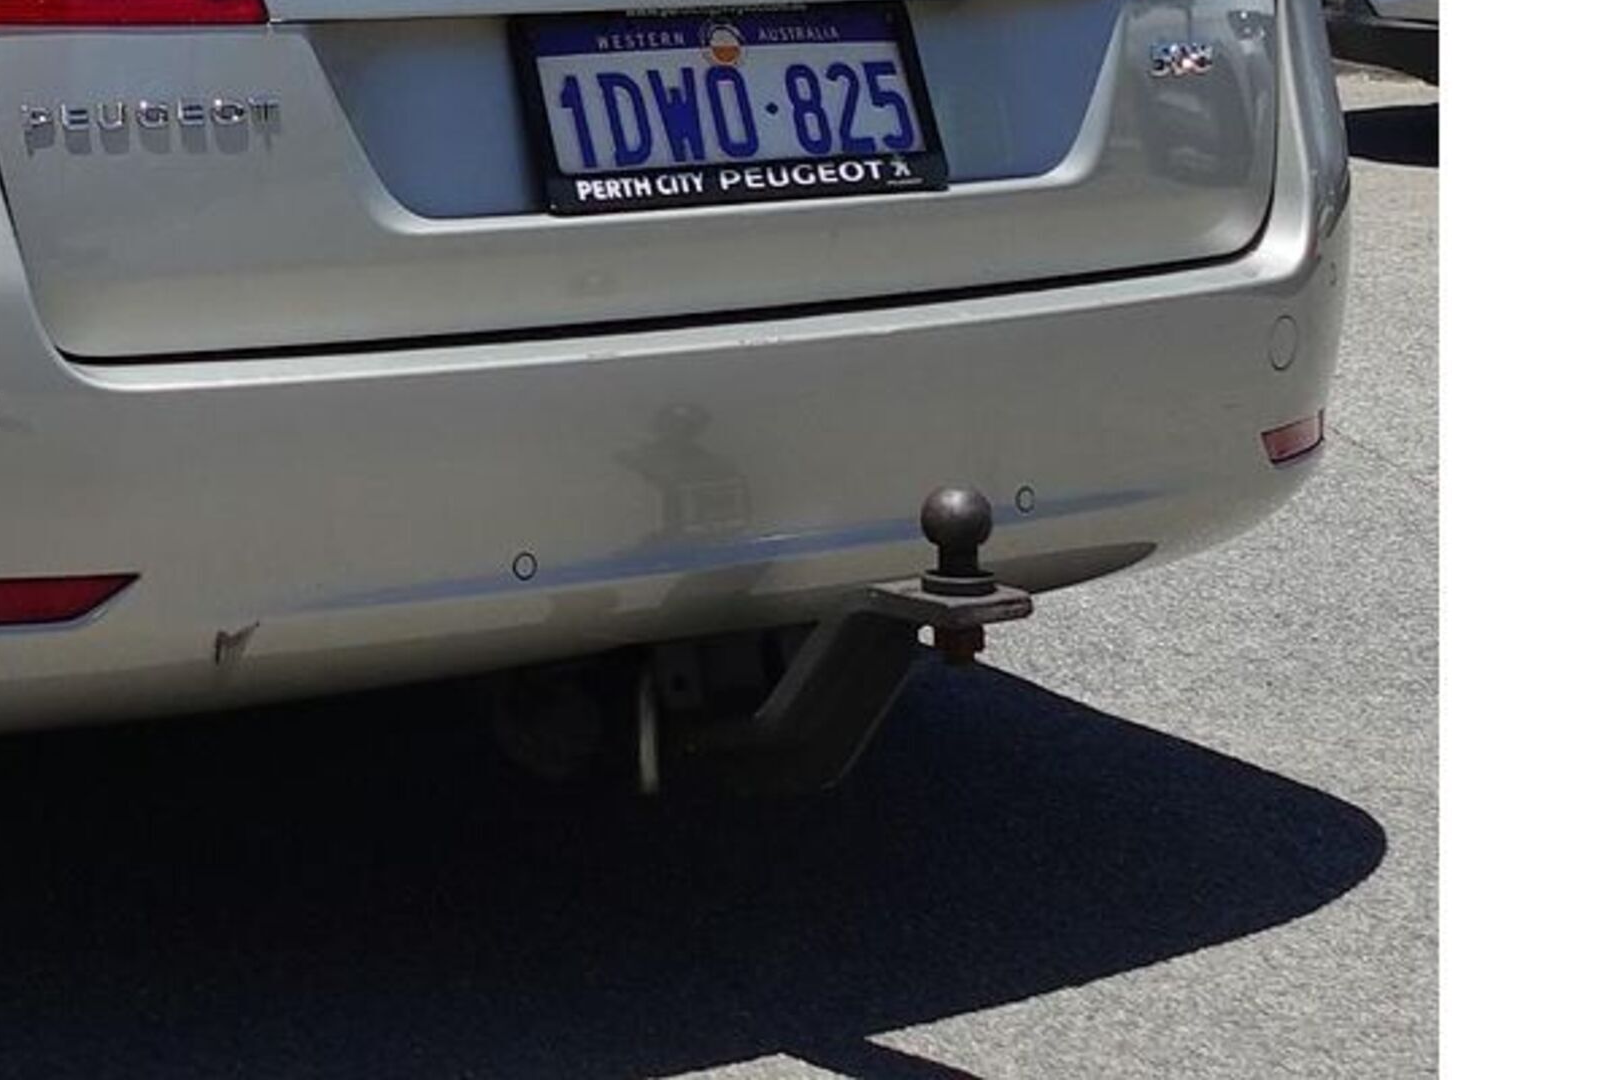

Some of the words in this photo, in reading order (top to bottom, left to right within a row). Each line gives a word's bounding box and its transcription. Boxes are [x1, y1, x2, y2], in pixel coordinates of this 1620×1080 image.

[575, 174, 652, 201] PERTH
[658, 169, 706, 196] CITY
[719, 160, 883, 192] PEUGEOT
